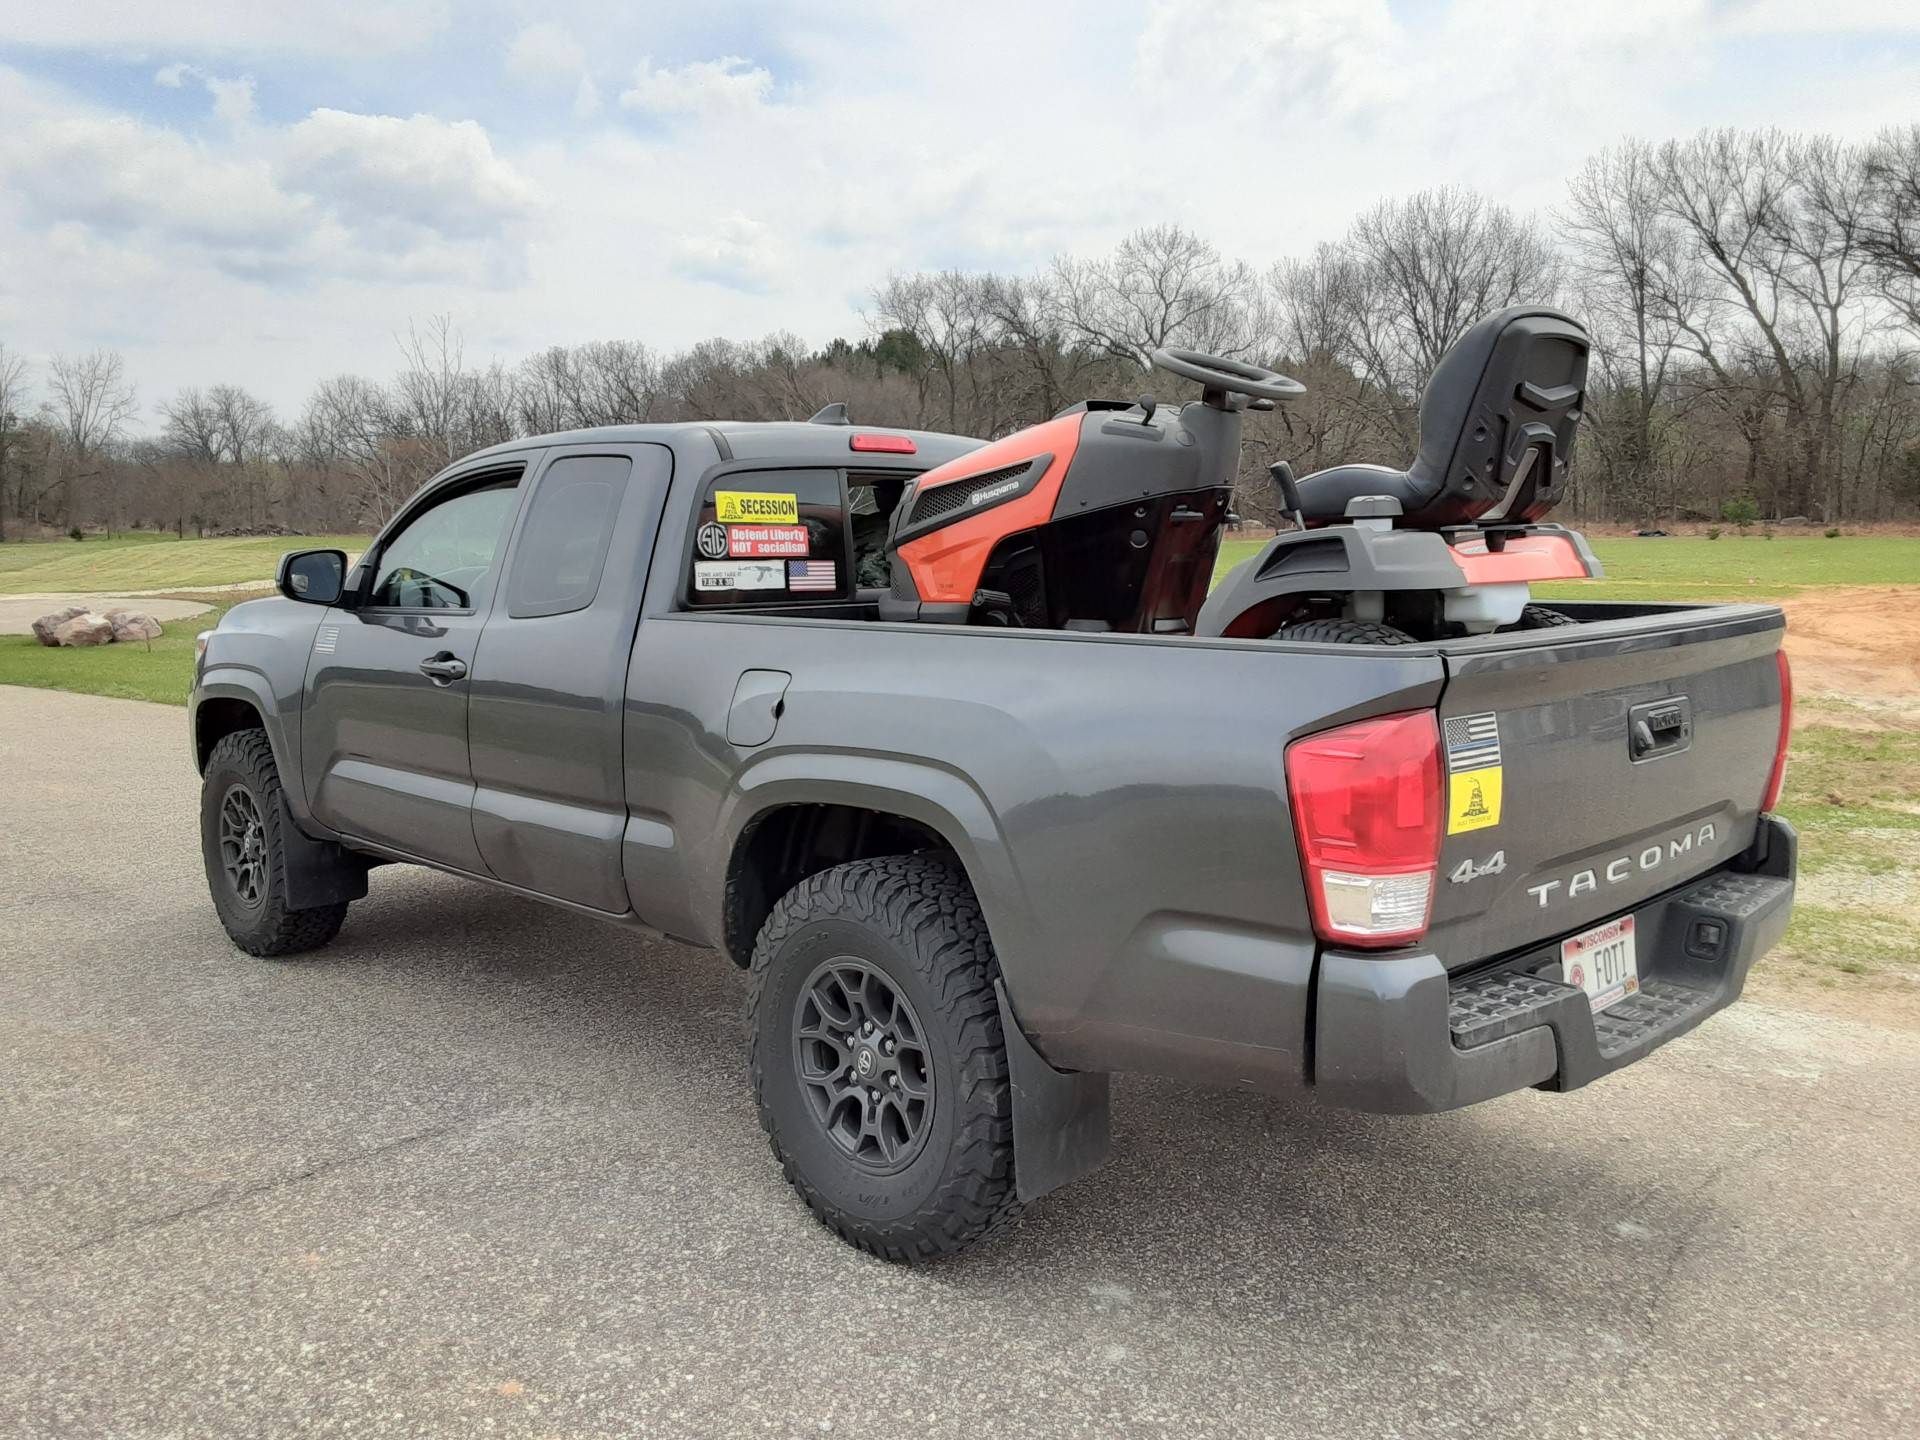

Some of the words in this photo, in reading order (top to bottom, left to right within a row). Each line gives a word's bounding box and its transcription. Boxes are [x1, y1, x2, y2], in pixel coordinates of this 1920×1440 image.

[980, 481, 1019, 501] Husqvarna
[740, 499, 795, 515] SECESSION
[702, 525, 725, 555] SIG
[732, 529, 768, 540] Defend
[770, 529, 804, 541] Liberty
[732, 542, 752, 553] NOT
[758, 542, 806, 553] socialism
[1451, 850, 1507, 883] 4x4
[1527, 823, 1718, 908] TACOMA
[1578, 924, 1619, 949] WISCONSIN
[1594, 940, 1628, 991] FOTI
